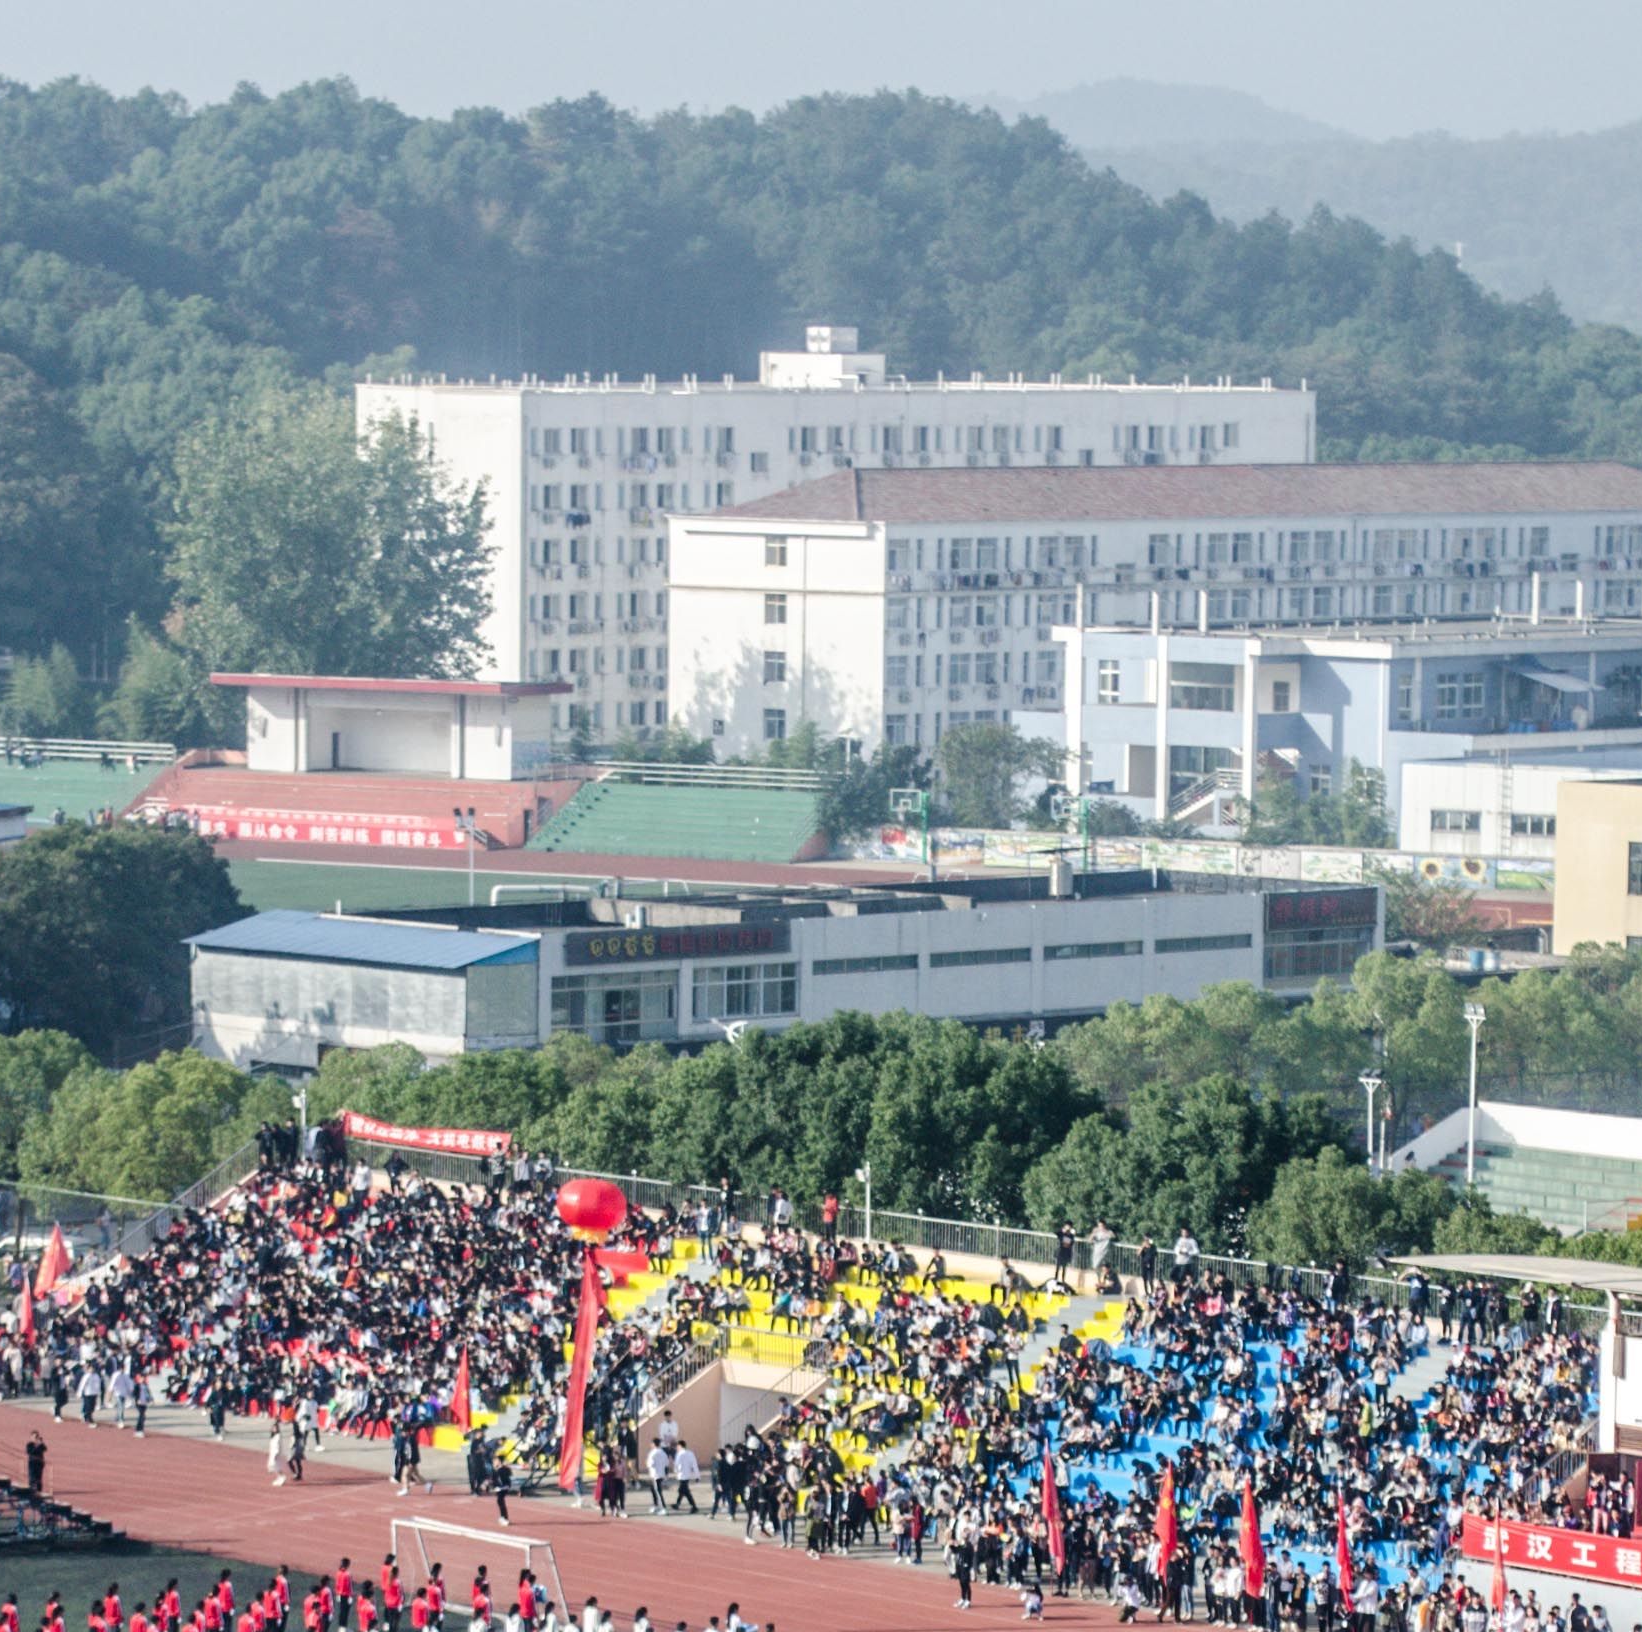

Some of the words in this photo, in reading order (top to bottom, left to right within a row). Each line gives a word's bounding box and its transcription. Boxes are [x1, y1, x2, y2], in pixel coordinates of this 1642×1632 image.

[310, 826, 370, 844] 刻苦训练
[381, 828, 442, 847] 团结奋斗
